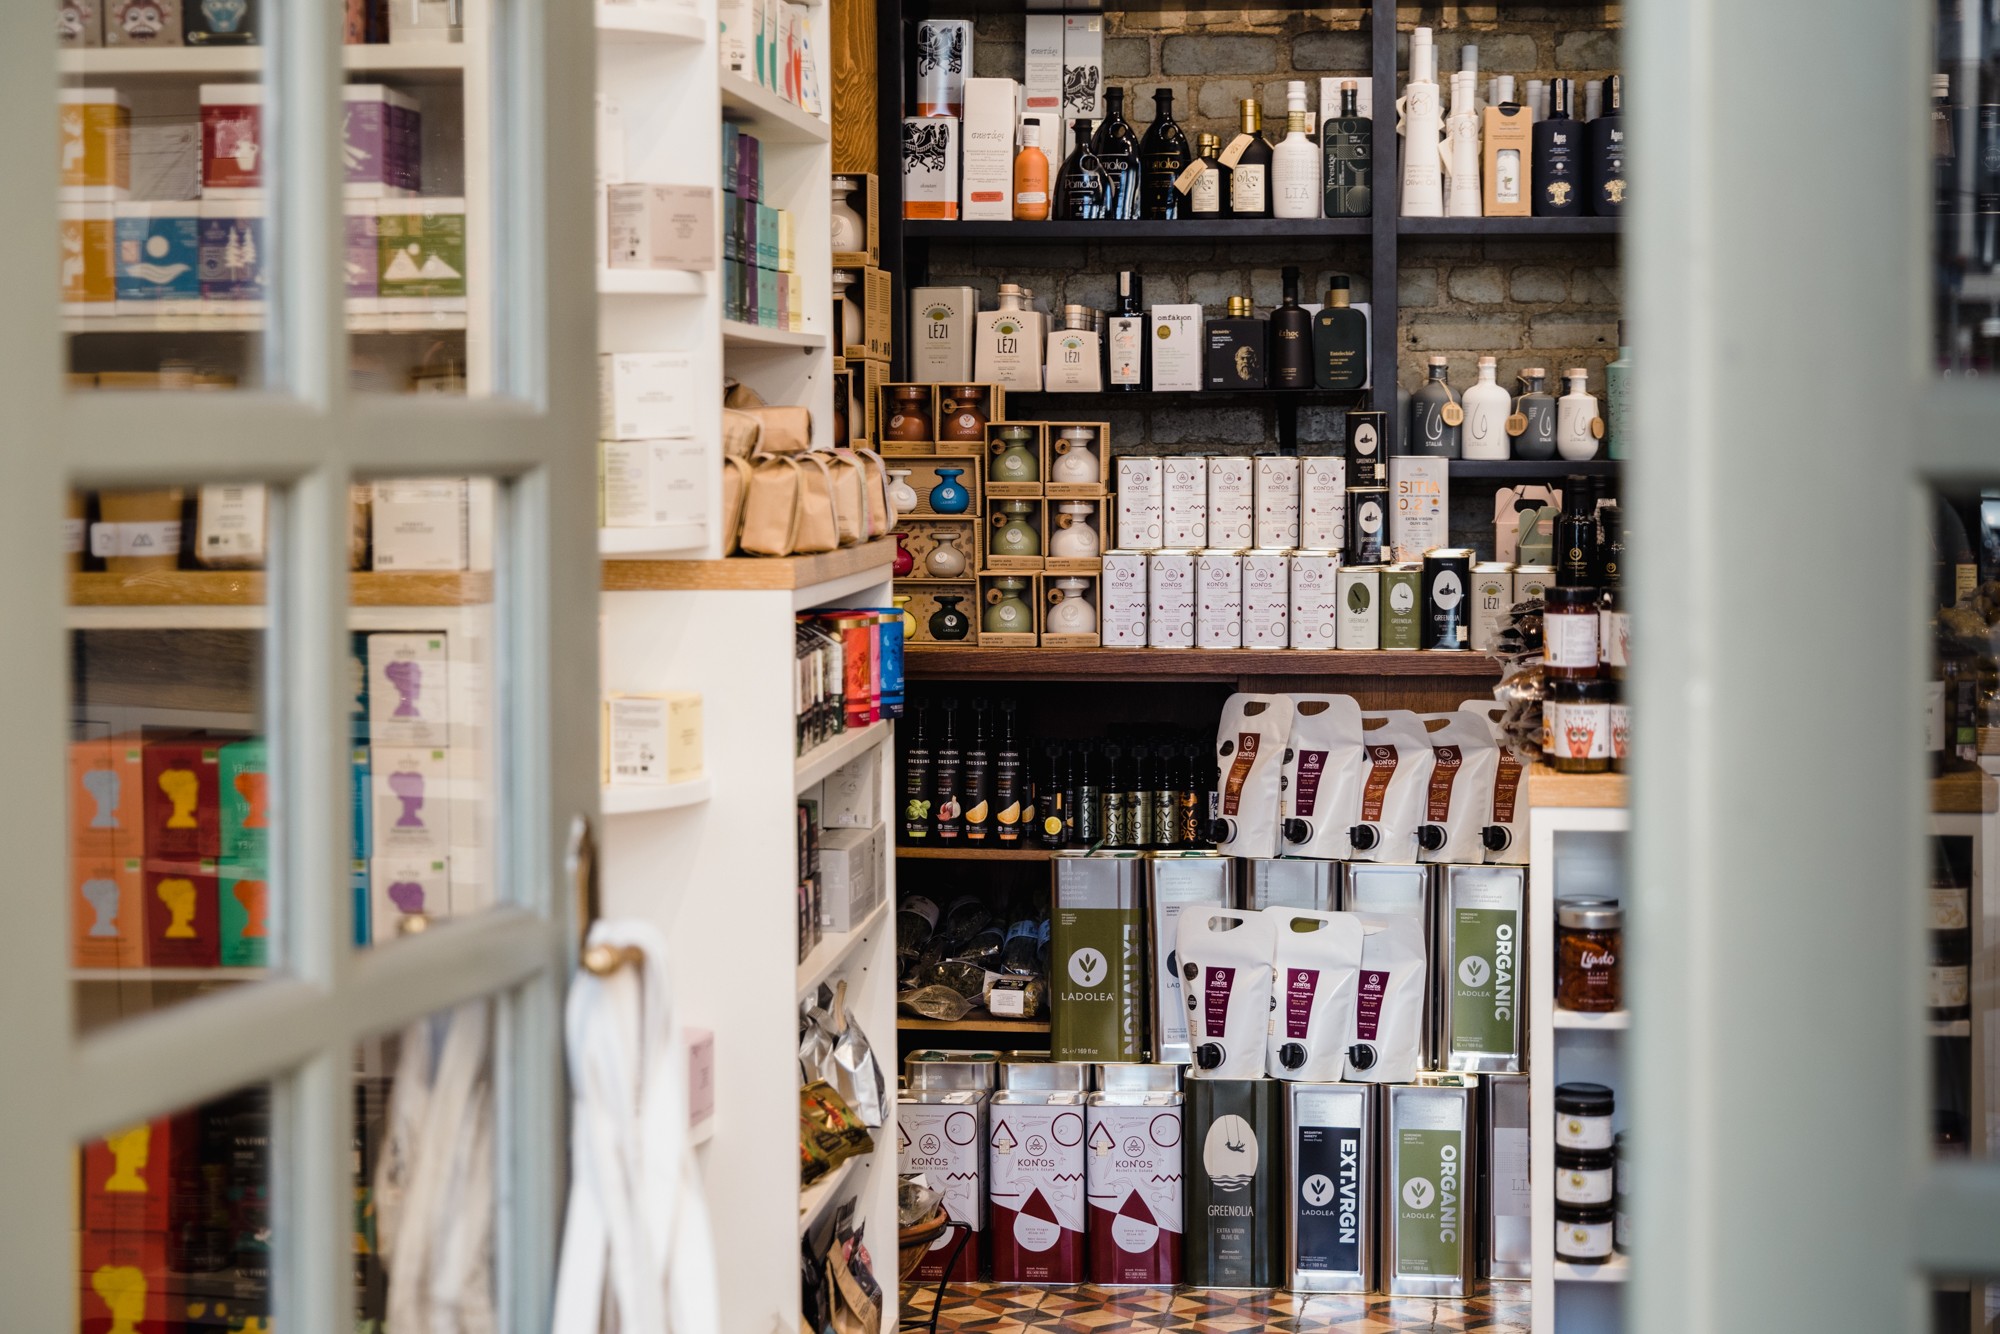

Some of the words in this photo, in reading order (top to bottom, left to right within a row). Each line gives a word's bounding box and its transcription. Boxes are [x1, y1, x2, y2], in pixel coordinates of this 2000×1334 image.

[1328, 154, 1337, 185] Prestige
[929, 323, 948, 338] LÉZI
[997, 336, 1017, 353] LÉZI
[1065, 350, 1080, 363] LÉZI
[1483, 596, 1500, 610] LÉZI
[1495, 924, 1513, 1021] ORGANIC
[1062, 992, 1114, 1001] LADOLEA
[1339, 1139, 1357, 1243] EXT.VRGN
[1440, 1145, 1457, 1244] ORGANIC
[1207, 1204, 1254, 1217] GREENOLIA
